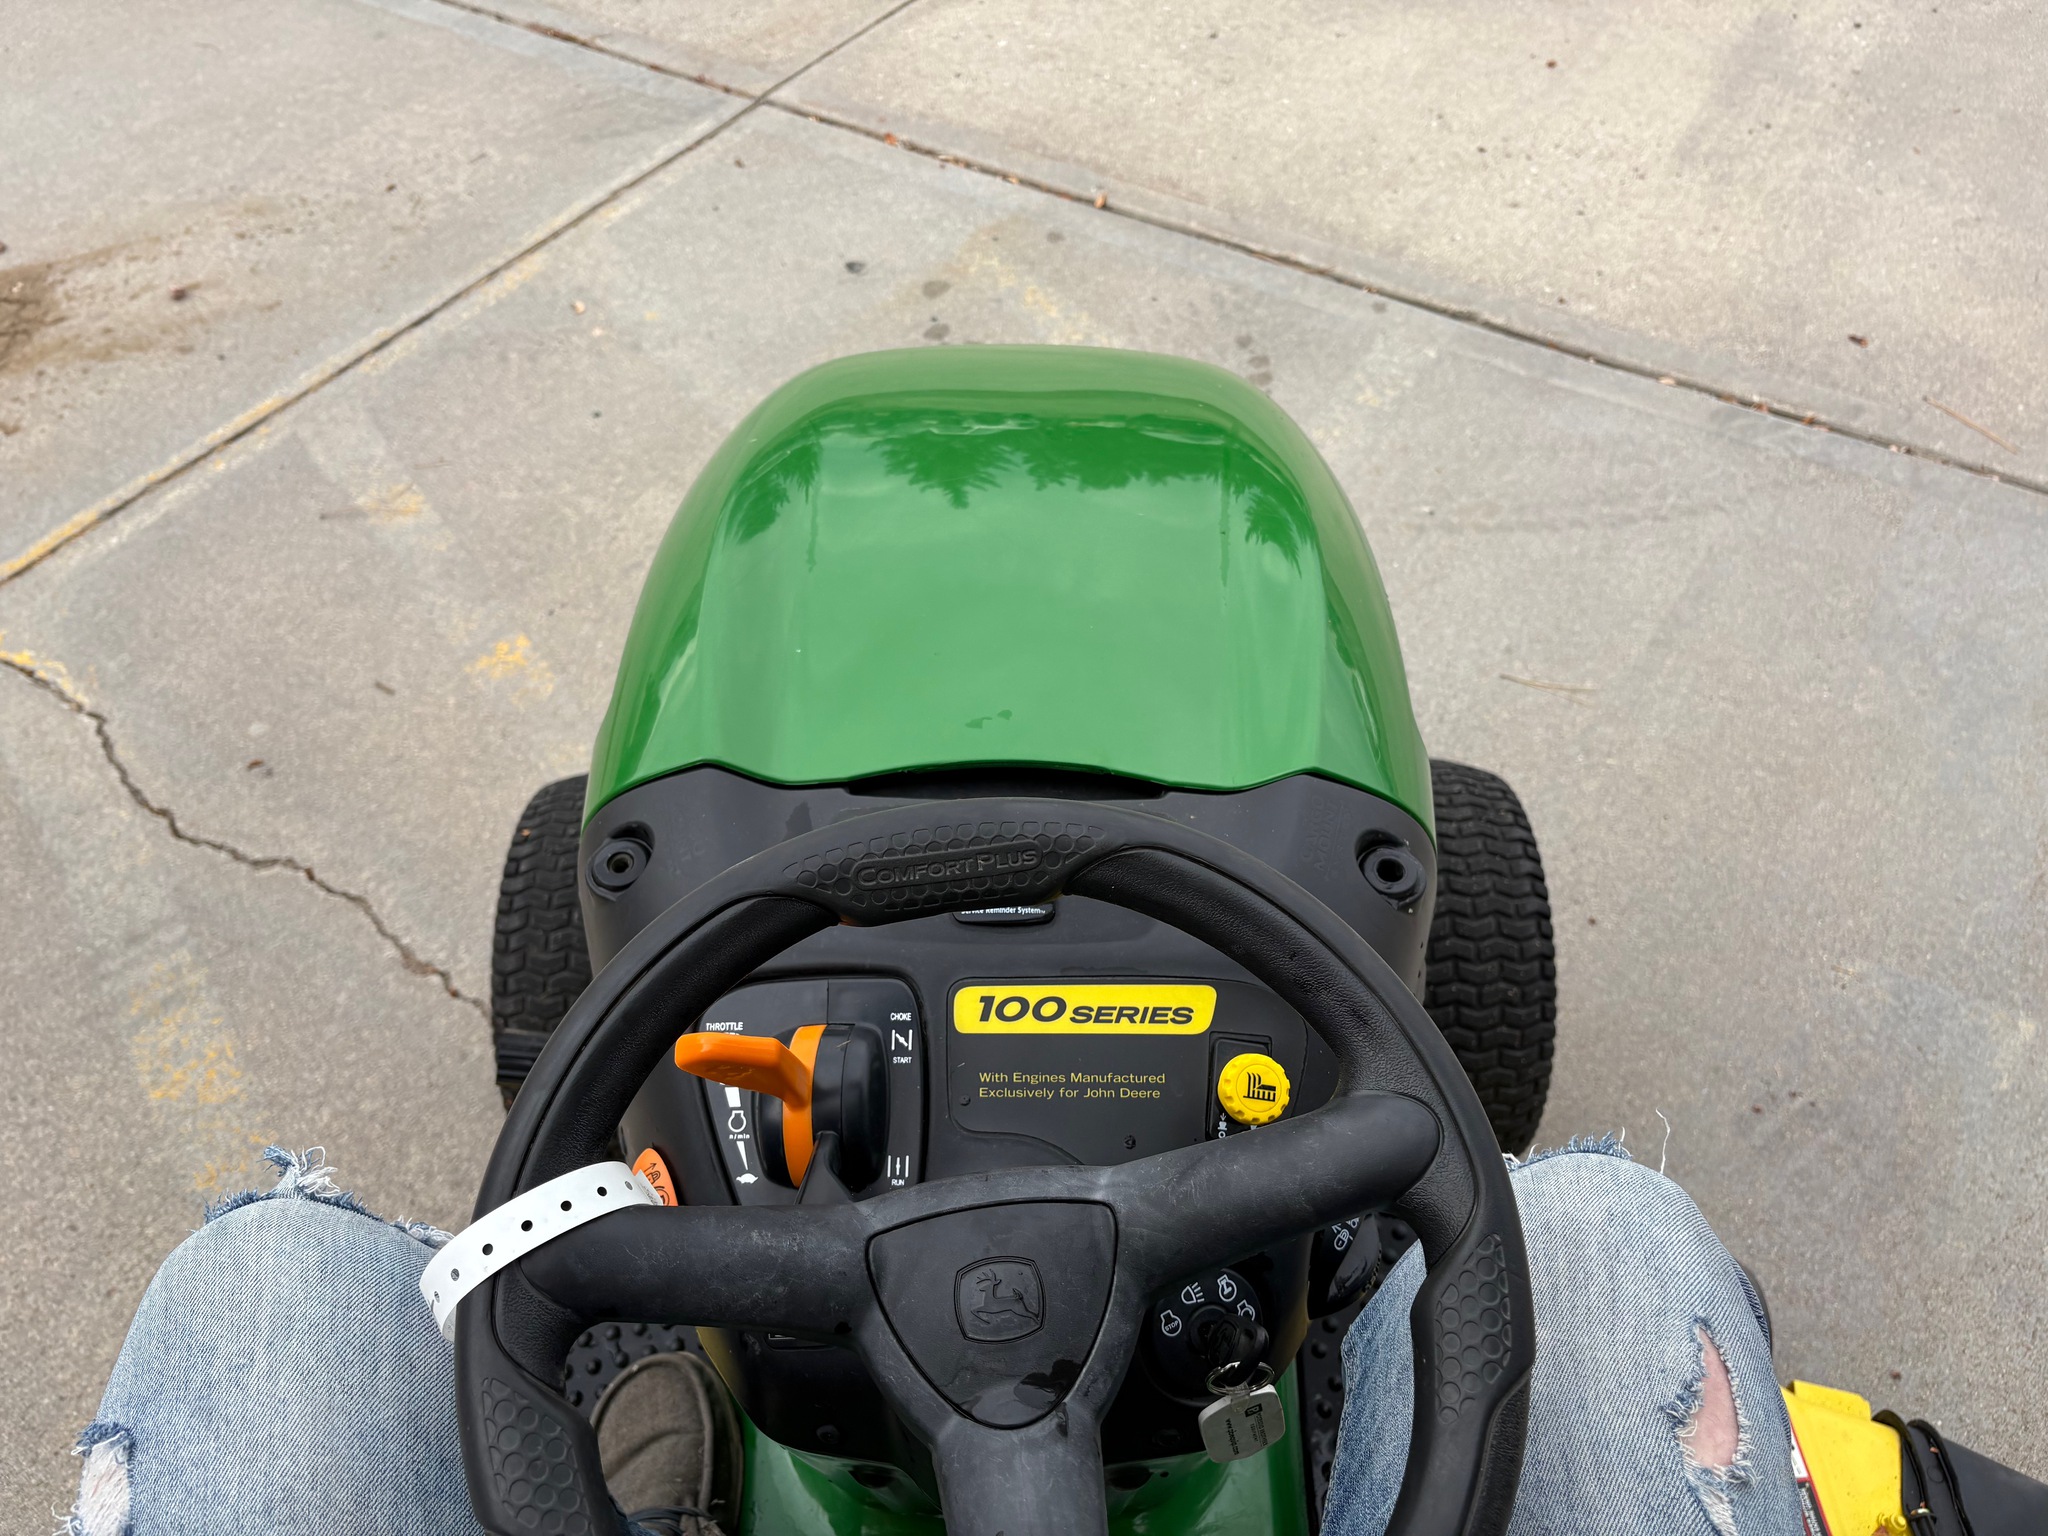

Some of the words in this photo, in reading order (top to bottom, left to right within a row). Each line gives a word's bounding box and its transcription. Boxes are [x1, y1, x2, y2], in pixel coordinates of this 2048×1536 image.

[979, 996, 1067, 1022] 100
[1069, 1005, 1195, 1025] SERIES
[890, 1012, 912, 1021] CHOKE
[705, 1021, 744, 1031] THROTTLE
[892, 1056, 912, 1064] START
[979, 1072, 1008, 1083] With
[1013, 1072, 1066, 1085] Engines
[1070, 1072, 1165, 1084] Manufactured
[979, 1087, 1055, 1100] Exclusively
[1059, 1087, 1079, 1098] for
[1083, 1087, 1115, 1098] John
[1120, 1087, 1160, 1098] Deere
[891, 1178, 905, 1186] RUN
